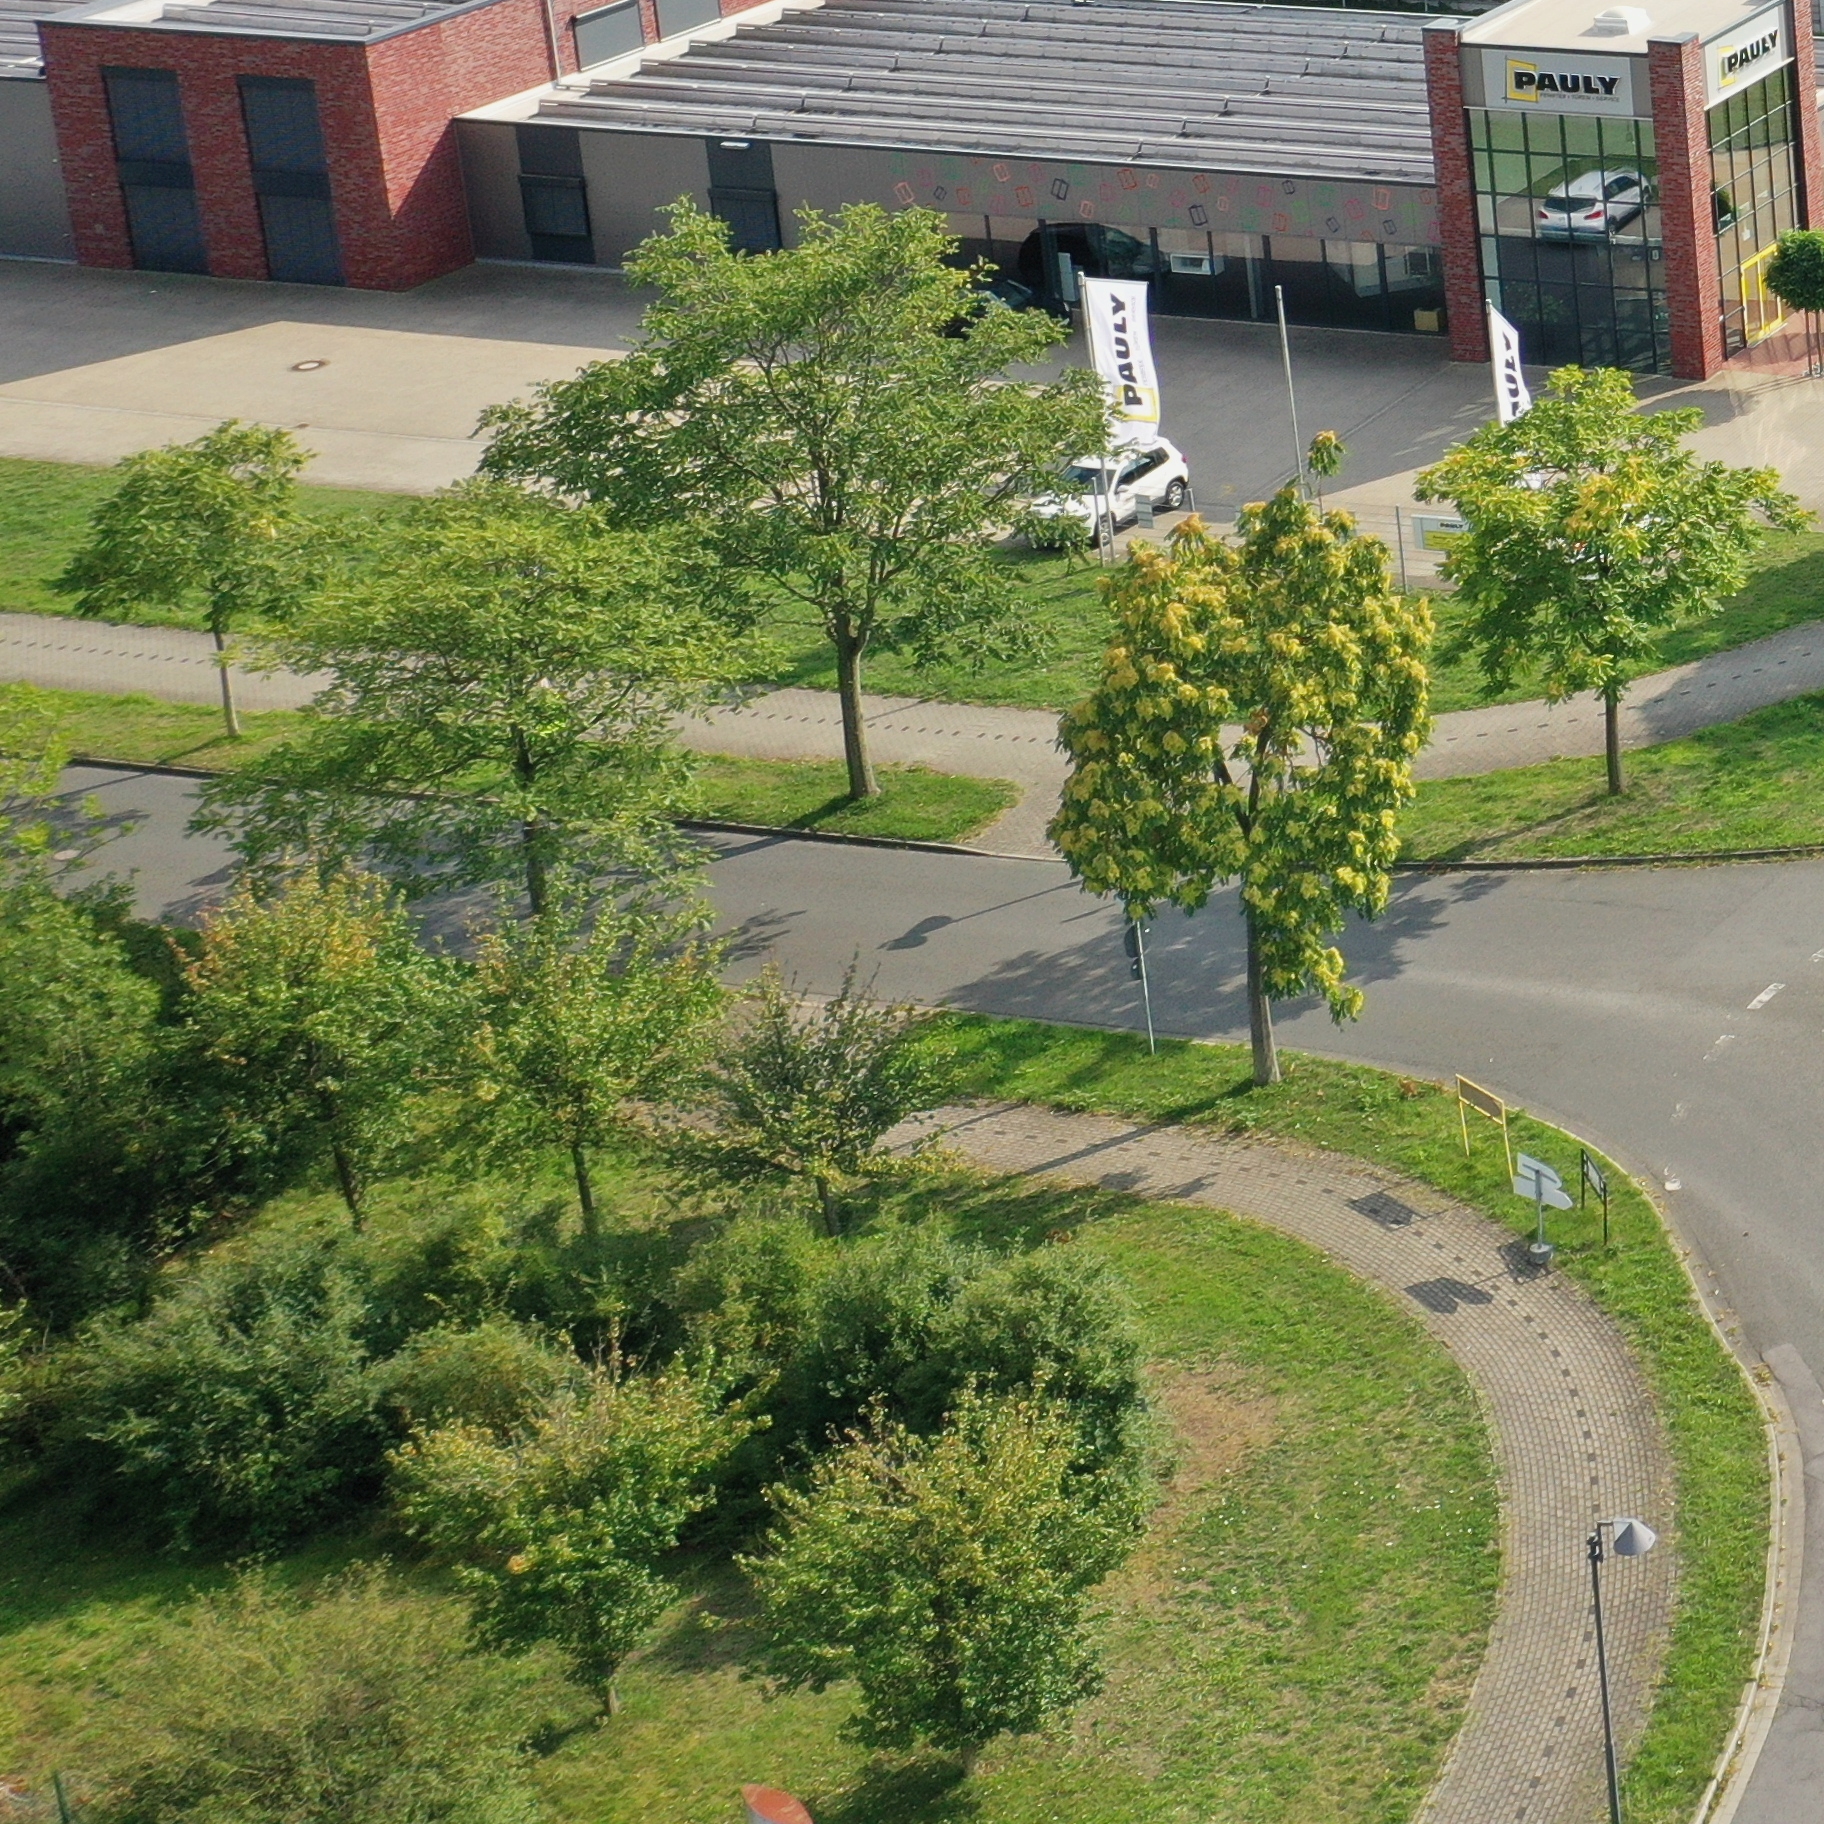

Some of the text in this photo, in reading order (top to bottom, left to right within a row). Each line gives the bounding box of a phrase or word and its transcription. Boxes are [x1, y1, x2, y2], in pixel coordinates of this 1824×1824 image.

[1726, 28, 1778, 72] PAULY
[1514, 69, 1621, 95] PAULY
[1110, 292, 1144, 406] PAULY
